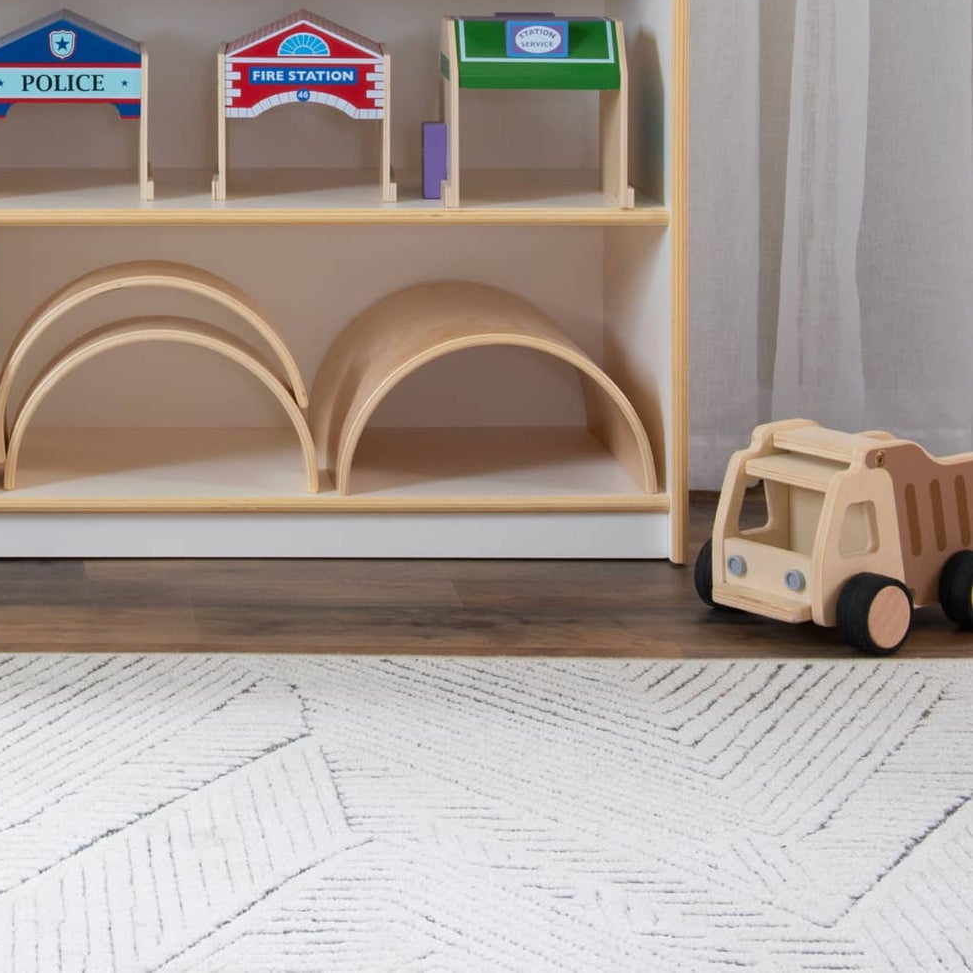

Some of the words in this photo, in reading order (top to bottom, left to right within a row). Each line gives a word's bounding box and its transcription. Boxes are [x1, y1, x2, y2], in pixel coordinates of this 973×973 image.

[518, 28, 557, 39] STATION
[253, 70, 285, 82] FIRE
[288, 70, 354, 82] STATION
[21, 74, 105, 92] POLICE
